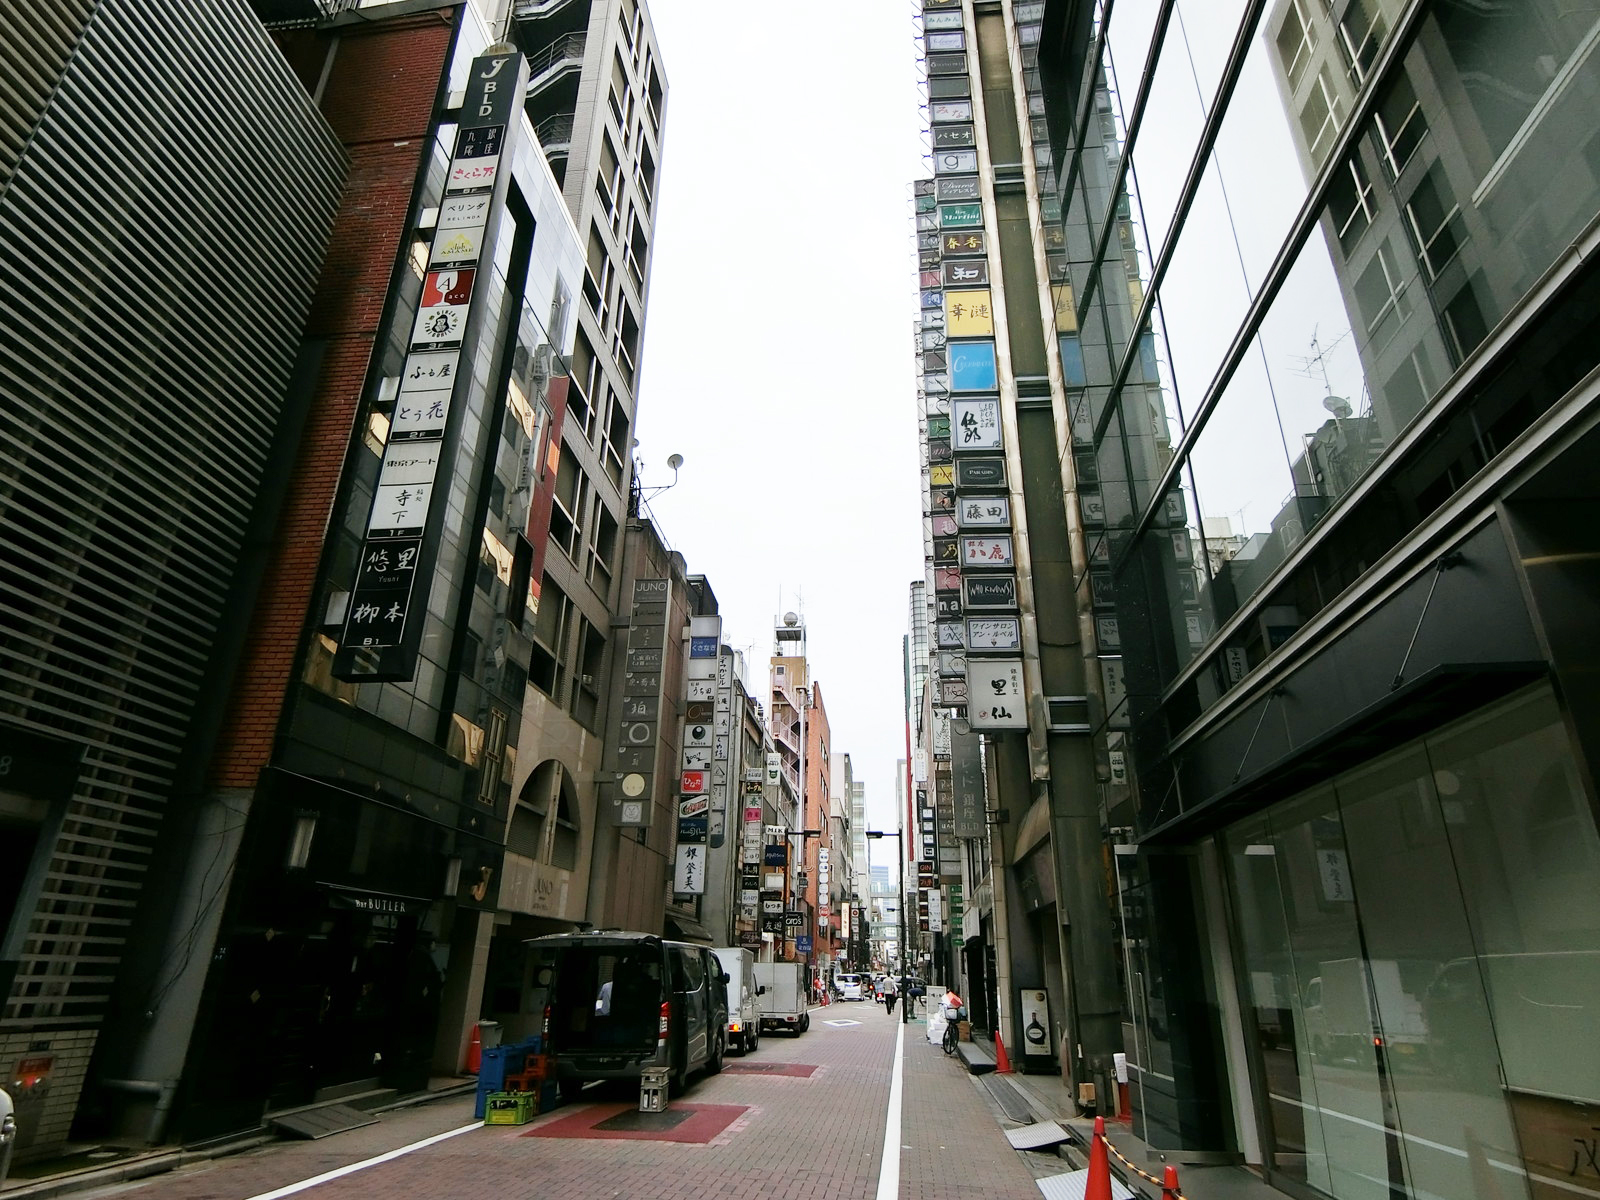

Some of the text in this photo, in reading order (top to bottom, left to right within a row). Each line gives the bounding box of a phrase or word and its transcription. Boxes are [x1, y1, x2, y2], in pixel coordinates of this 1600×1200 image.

[484, 128, 496, 154] 銀座
[452, 166, 495, 180] さくら乃
[448, 202, 486, 212] ベリンダ
[944, 212, 980, 220] Martini
[946, 236, 982, 249] 春香
[952, 266, 979, 280] 和
[438, 276, 450, 290] A
[400, 400, 444, 420] とう花
[387, 458, 436, 468] 東京アート
[392, 489, 412, 524] 寺下
[966, 504, 1002, 520] 藤田
[366, 547, 416, 572] 悠里
[636, 582, 667, 592] JUNO
[353, 602, 404, 624] 柳本
[363, 637, 380, 646] B1
[368, 898, 406, 912] BUTLER
